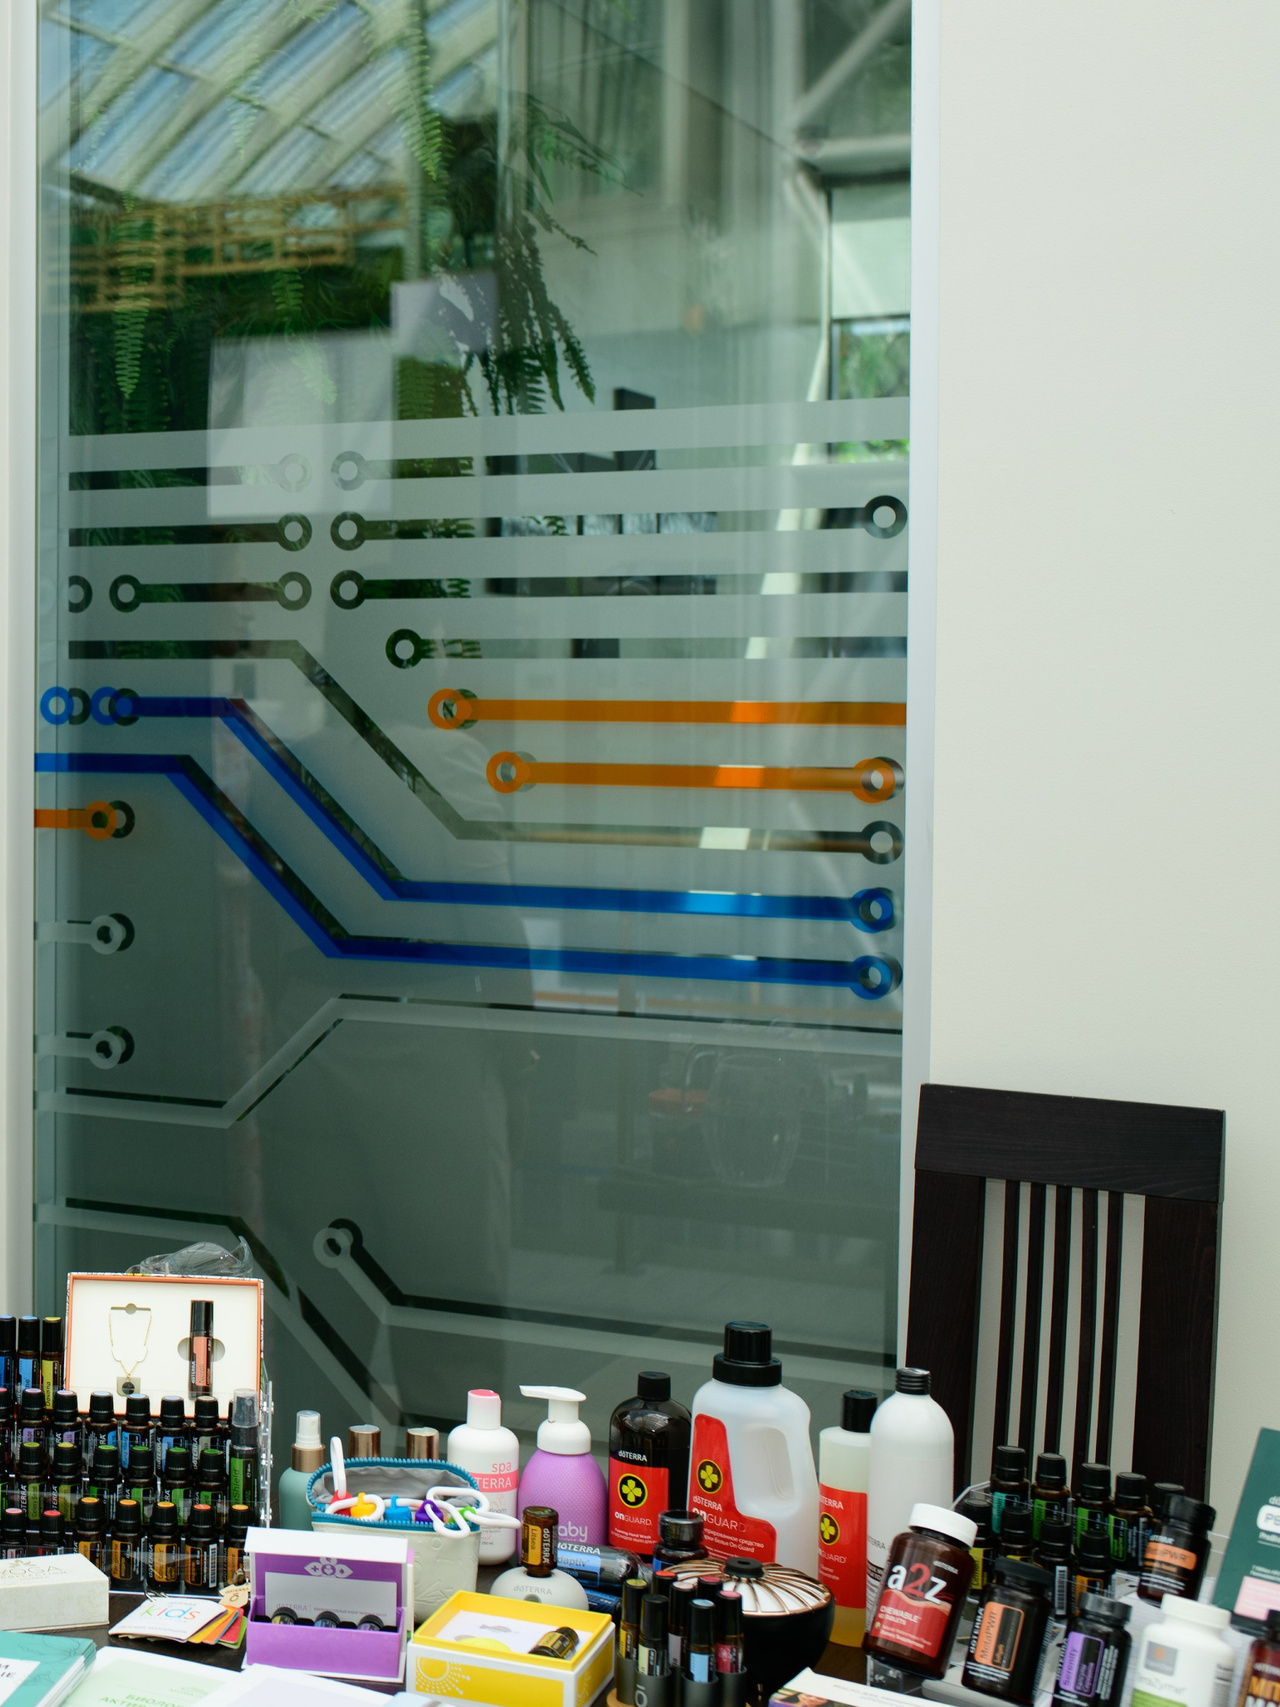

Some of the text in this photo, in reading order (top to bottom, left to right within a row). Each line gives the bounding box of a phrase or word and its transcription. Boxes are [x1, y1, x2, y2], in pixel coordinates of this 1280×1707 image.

[491, 1461, 512, 1474] spa
[475, 1477, 512, 1490] TERRA
[557, 1521, 588, 1543] aby
[557, 1555, 587, 1568] daptiv
[887, 1563, 947, 1605] a2z
[141, 1604, 201, 1620] kids
[1063, 1648, 1080, 1686] Serenity
